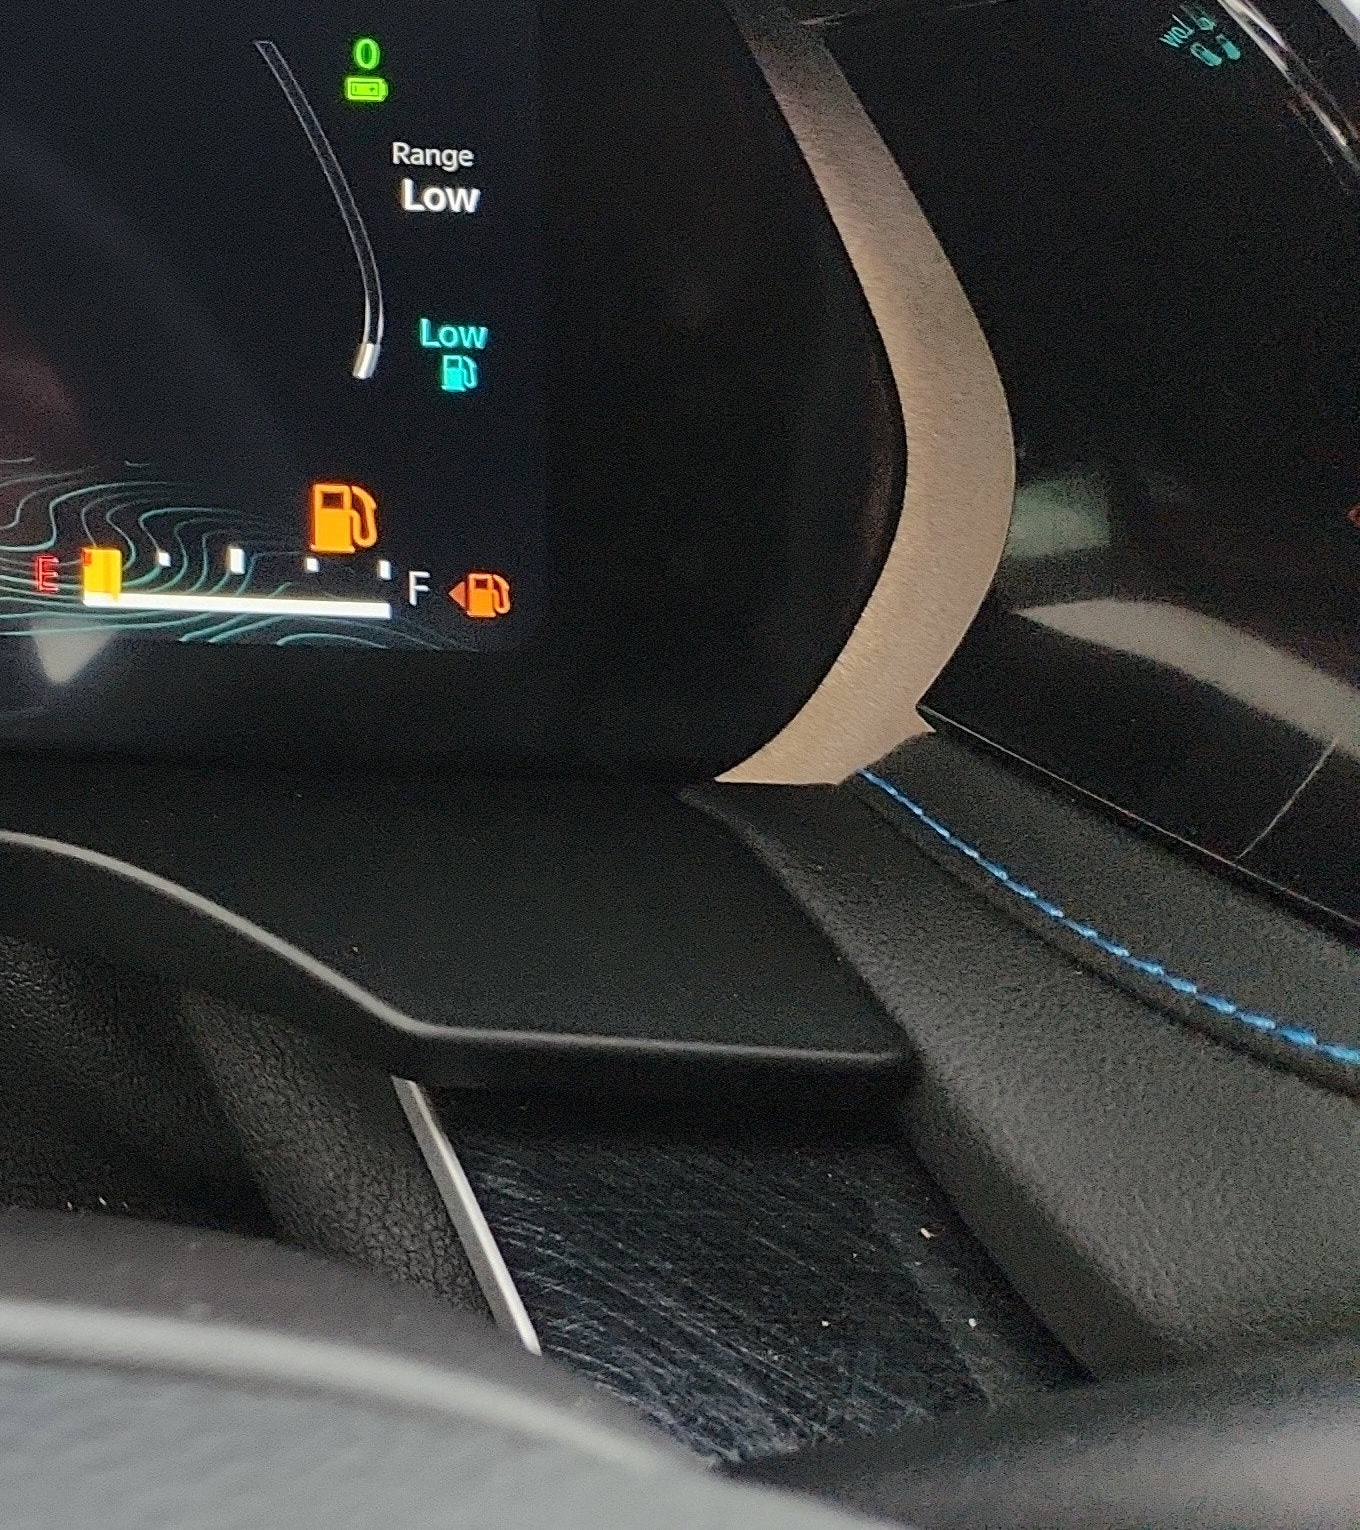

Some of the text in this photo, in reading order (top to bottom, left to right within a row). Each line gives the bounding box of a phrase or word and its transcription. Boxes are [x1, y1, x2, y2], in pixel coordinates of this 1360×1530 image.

[353, 38, 381, 71] 0
[392, 141, 475, 173] Range
[401, 177, 481, 213] Low
[419, 318, 489, 349] Low
[37, 555, 60, 596] E
[408, 570, 431, 606] F
